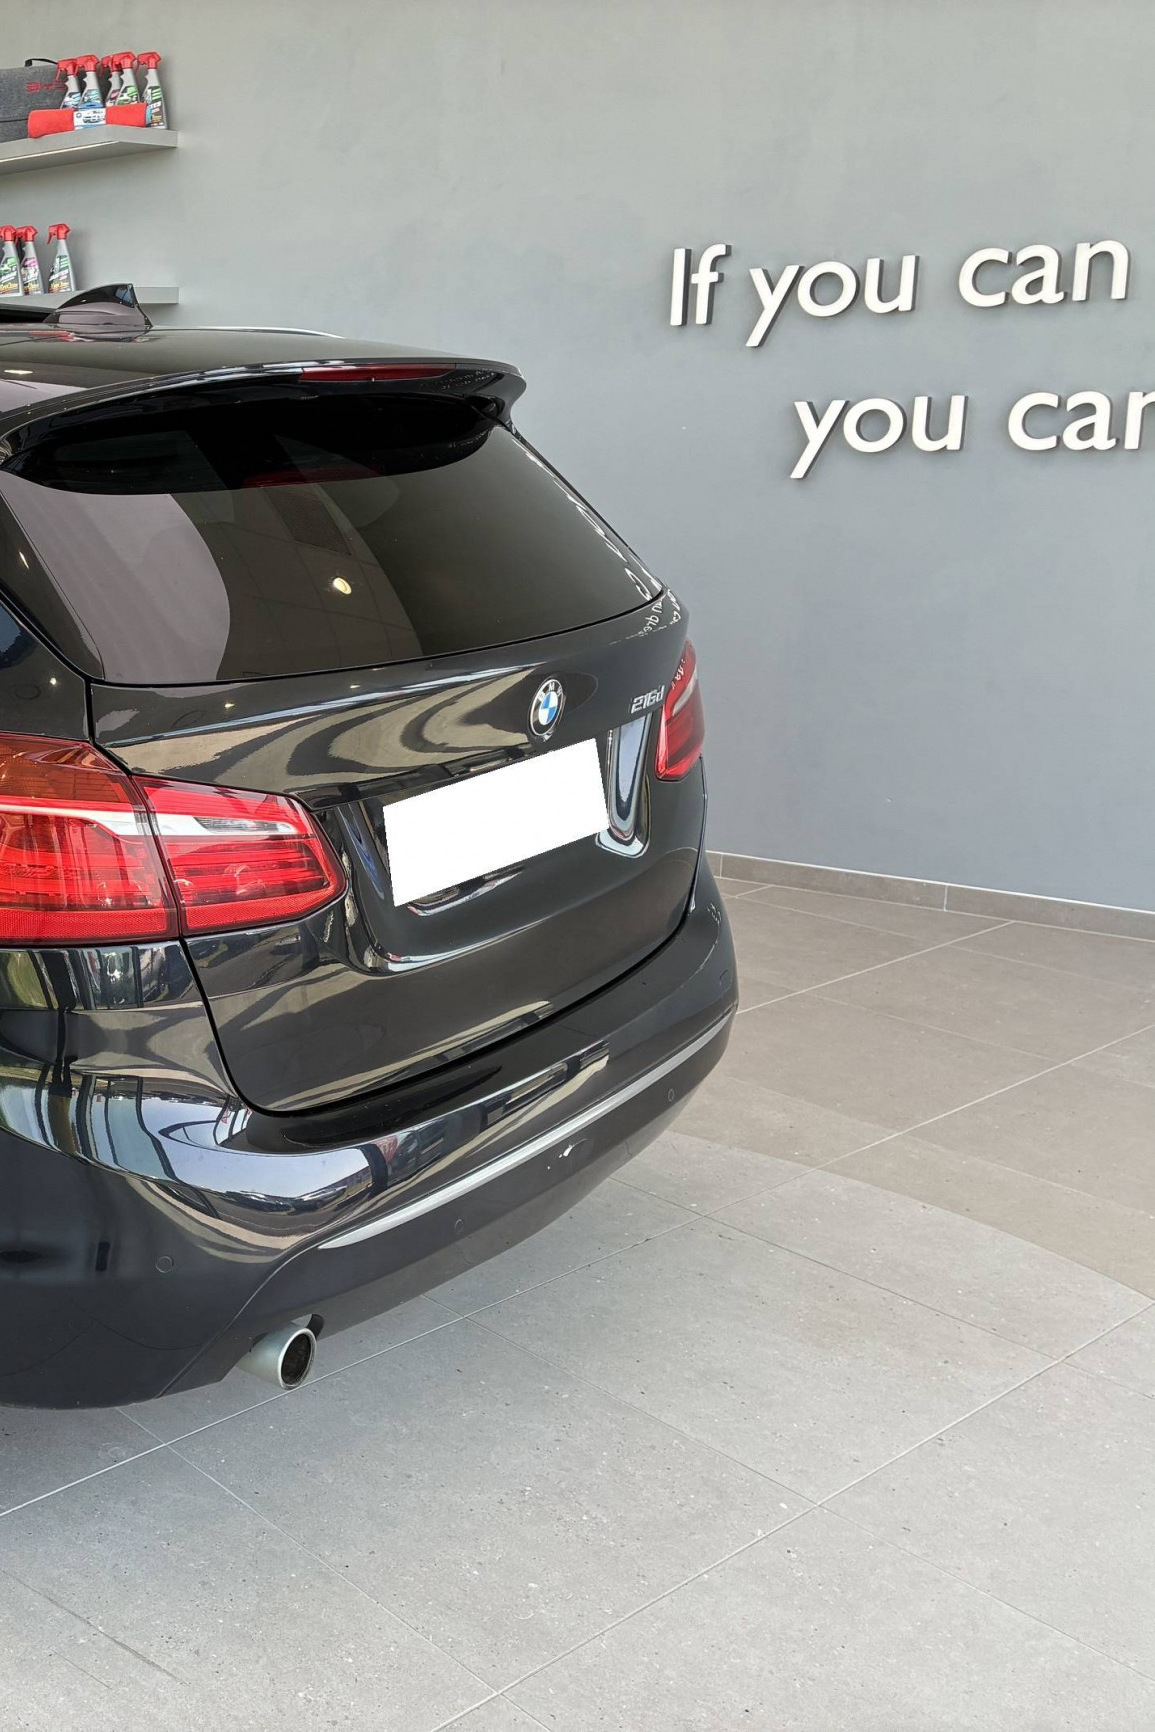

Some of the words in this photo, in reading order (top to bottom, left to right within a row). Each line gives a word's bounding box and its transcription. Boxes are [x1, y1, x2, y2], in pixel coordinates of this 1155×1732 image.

[670, 244, 731, 326] If
[746, 254, 920, 347] you
[958, 239, 1130, 308] can
[790, 394, 969, 479] you
[630, 685, 665, 714] 216d
